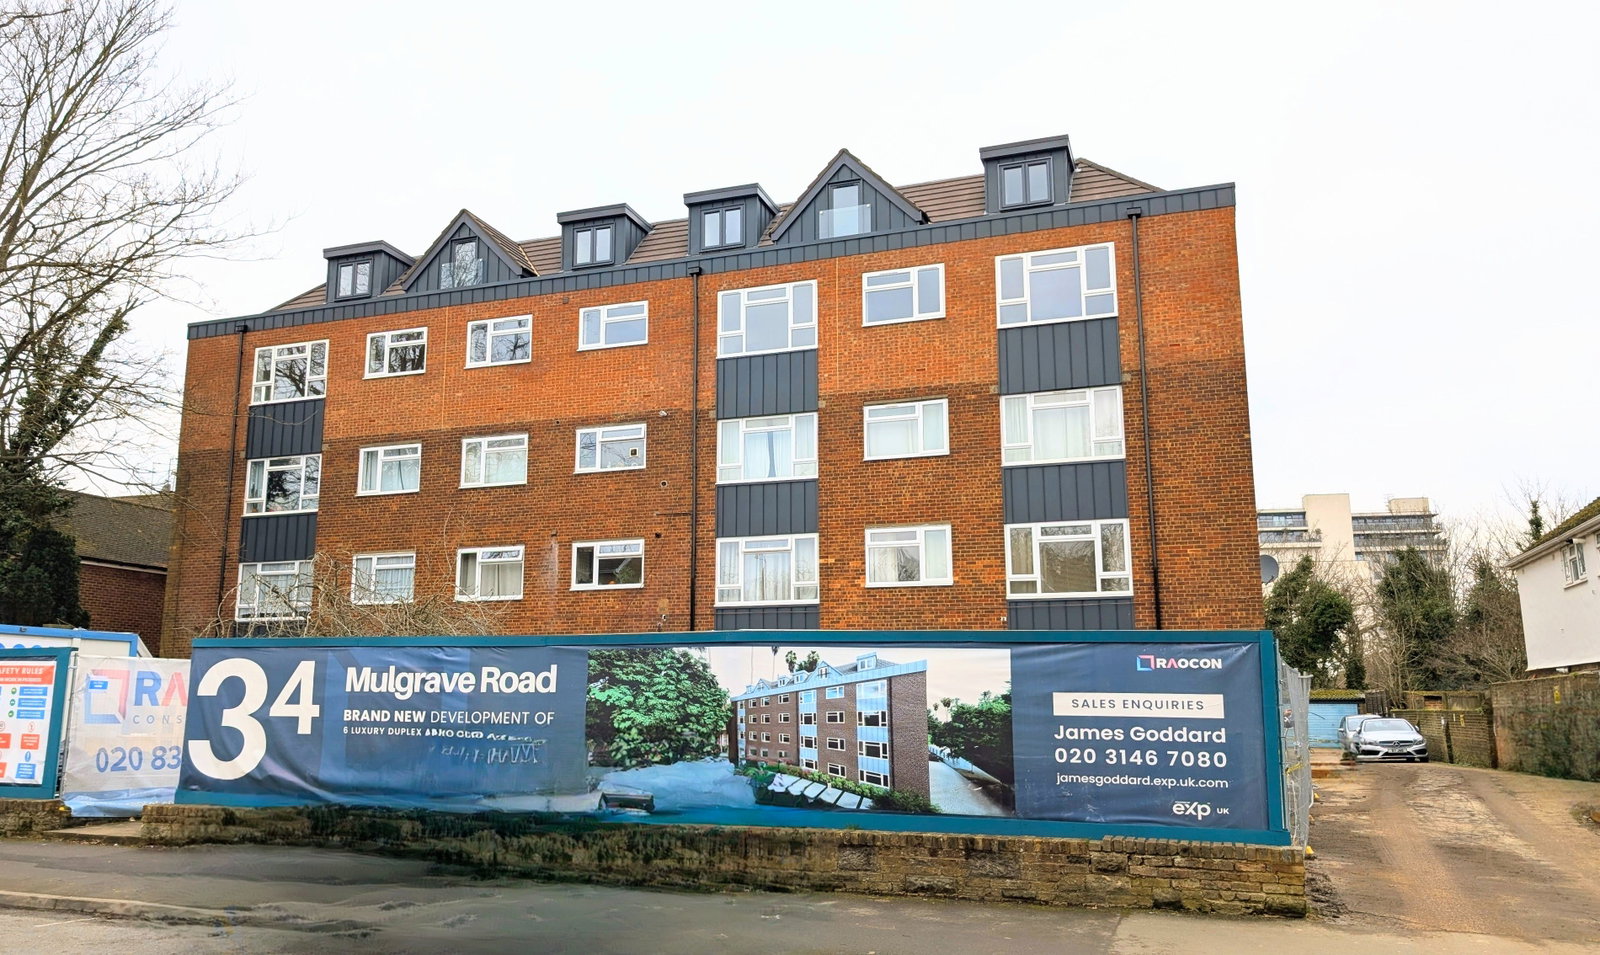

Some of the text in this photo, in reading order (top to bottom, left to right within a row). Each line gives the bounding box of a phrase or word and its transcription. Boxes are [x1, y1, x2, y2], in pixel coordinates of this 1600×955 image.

[1155, 658, 1222, 670] RAOCON
[345, 664, 558, 700] Mulgrave Road
[1071, 698, 1204, 711] SALES ENQUIRIES
[188, 657, 320, 780] 34
[343, 709, 555, 726] BRAND NEW DEVELOPMENT OF
[343, 726, 349, 735] 6
[351, 727, 385, 736] LUXURY
[388, 727, 422, 737] DUPLEX
[1053, 725, 1227, 744] James Goddard
[96, 746, 143, 773] 020
[1054, 747, 1228, 768] 020 3146 7080
[1056, 772, 1229, 789] jamesgoddard.exp.uk.com
